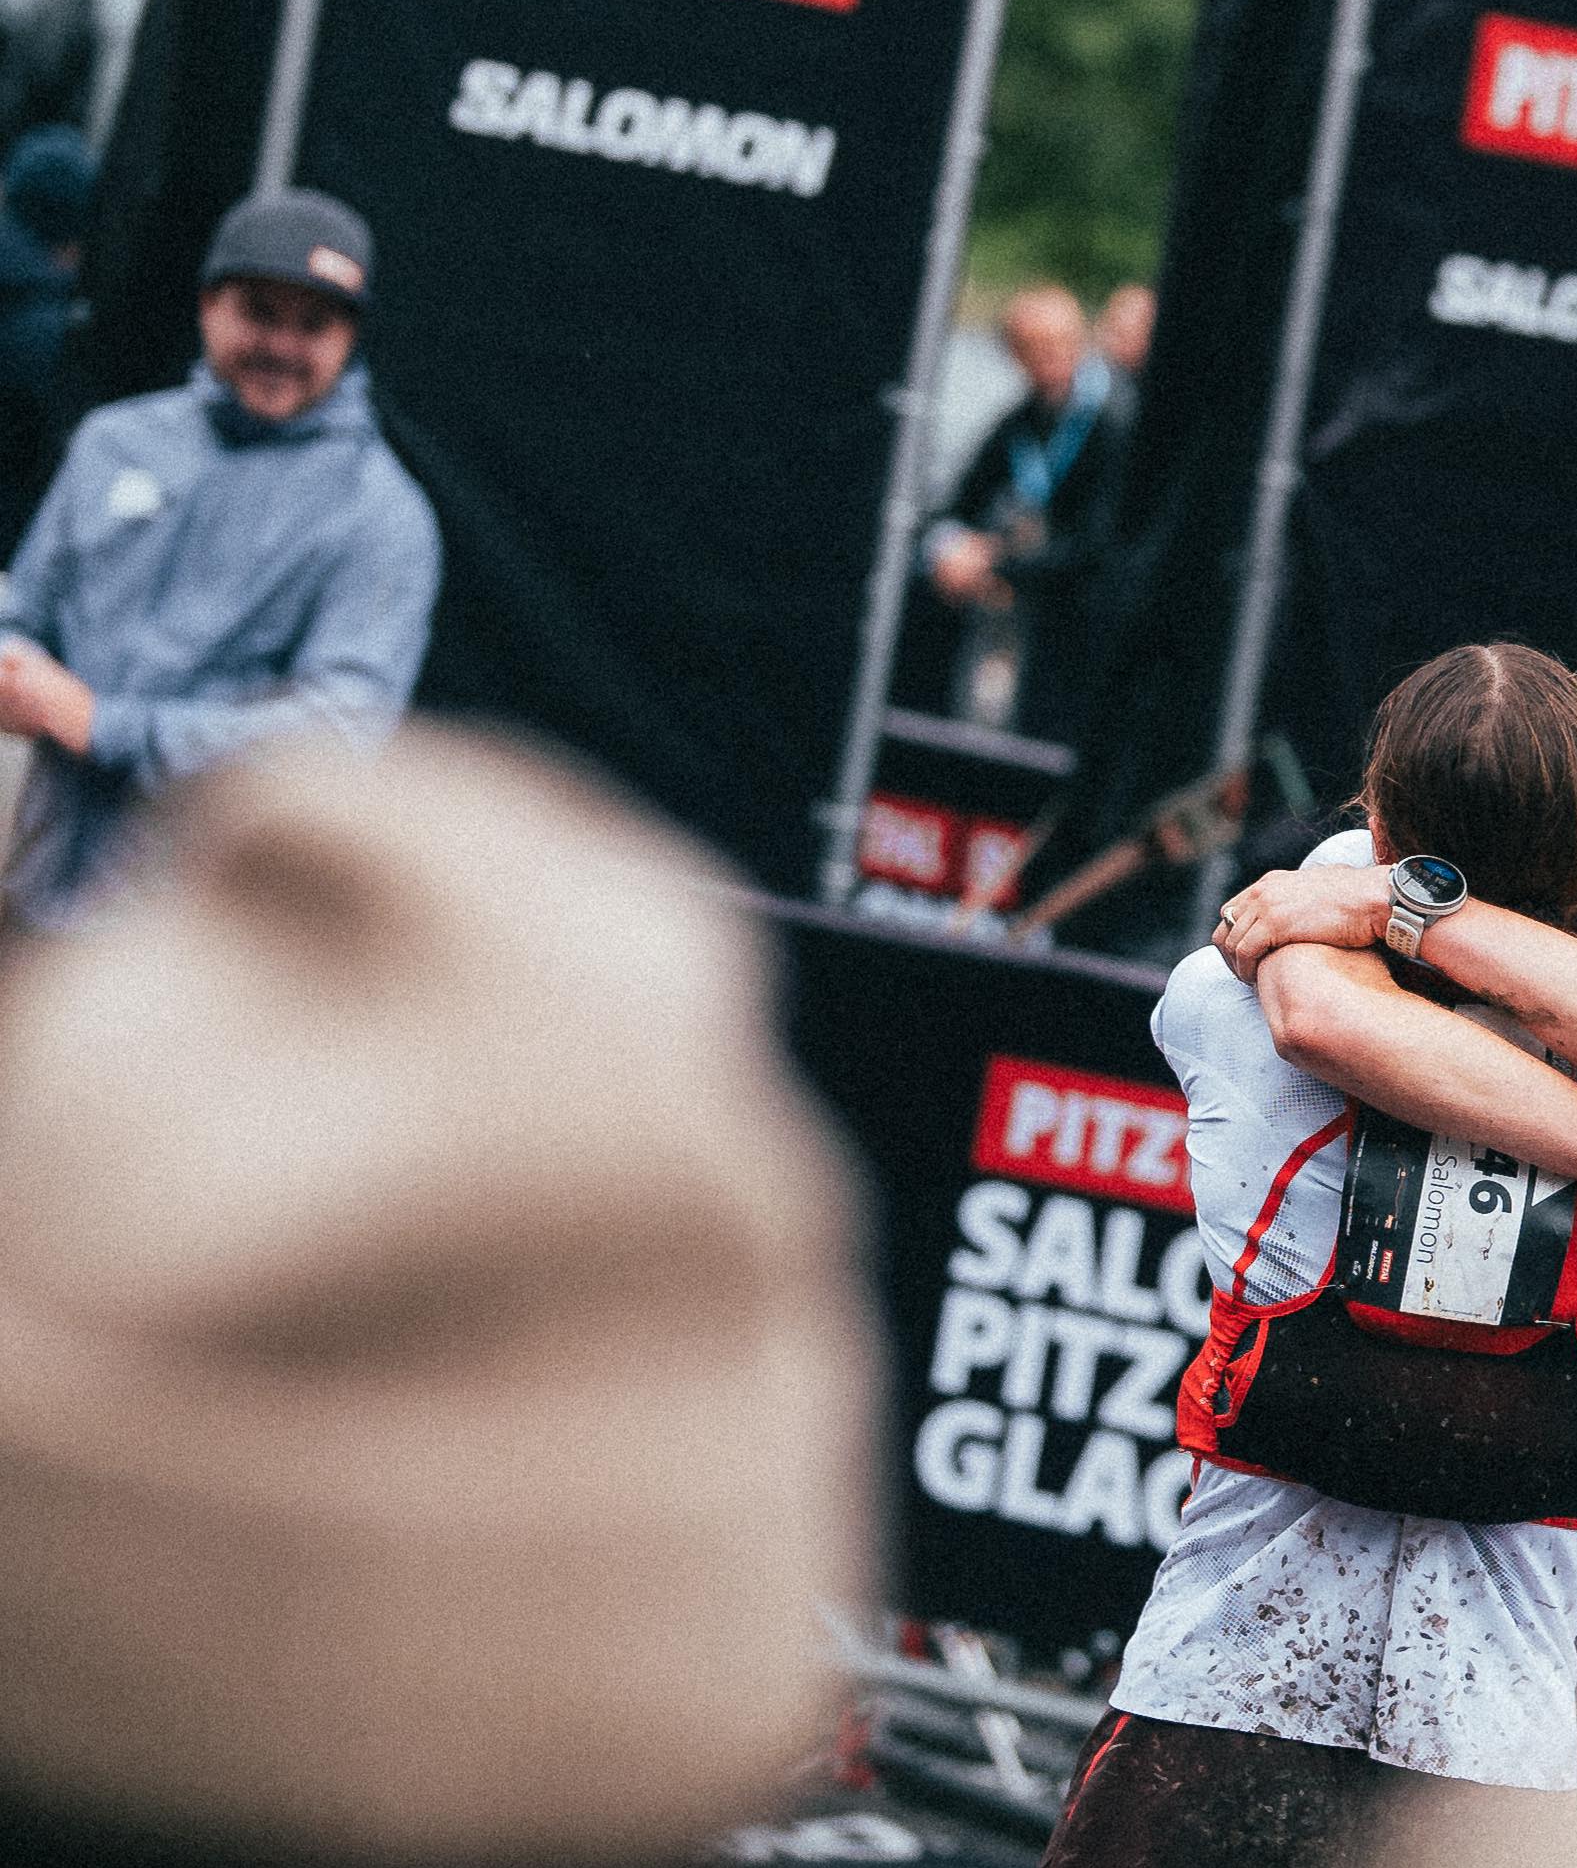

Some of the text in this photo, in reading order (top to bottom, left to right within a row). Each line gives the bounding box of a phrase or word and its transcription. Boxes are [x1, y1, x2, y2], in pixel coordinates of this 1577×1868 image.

[448, 57, 838, 199] SALOMON
[1416, 1153, 1458, 1264] Salomon
[929, 1284, 1190, 1437] PITZ
